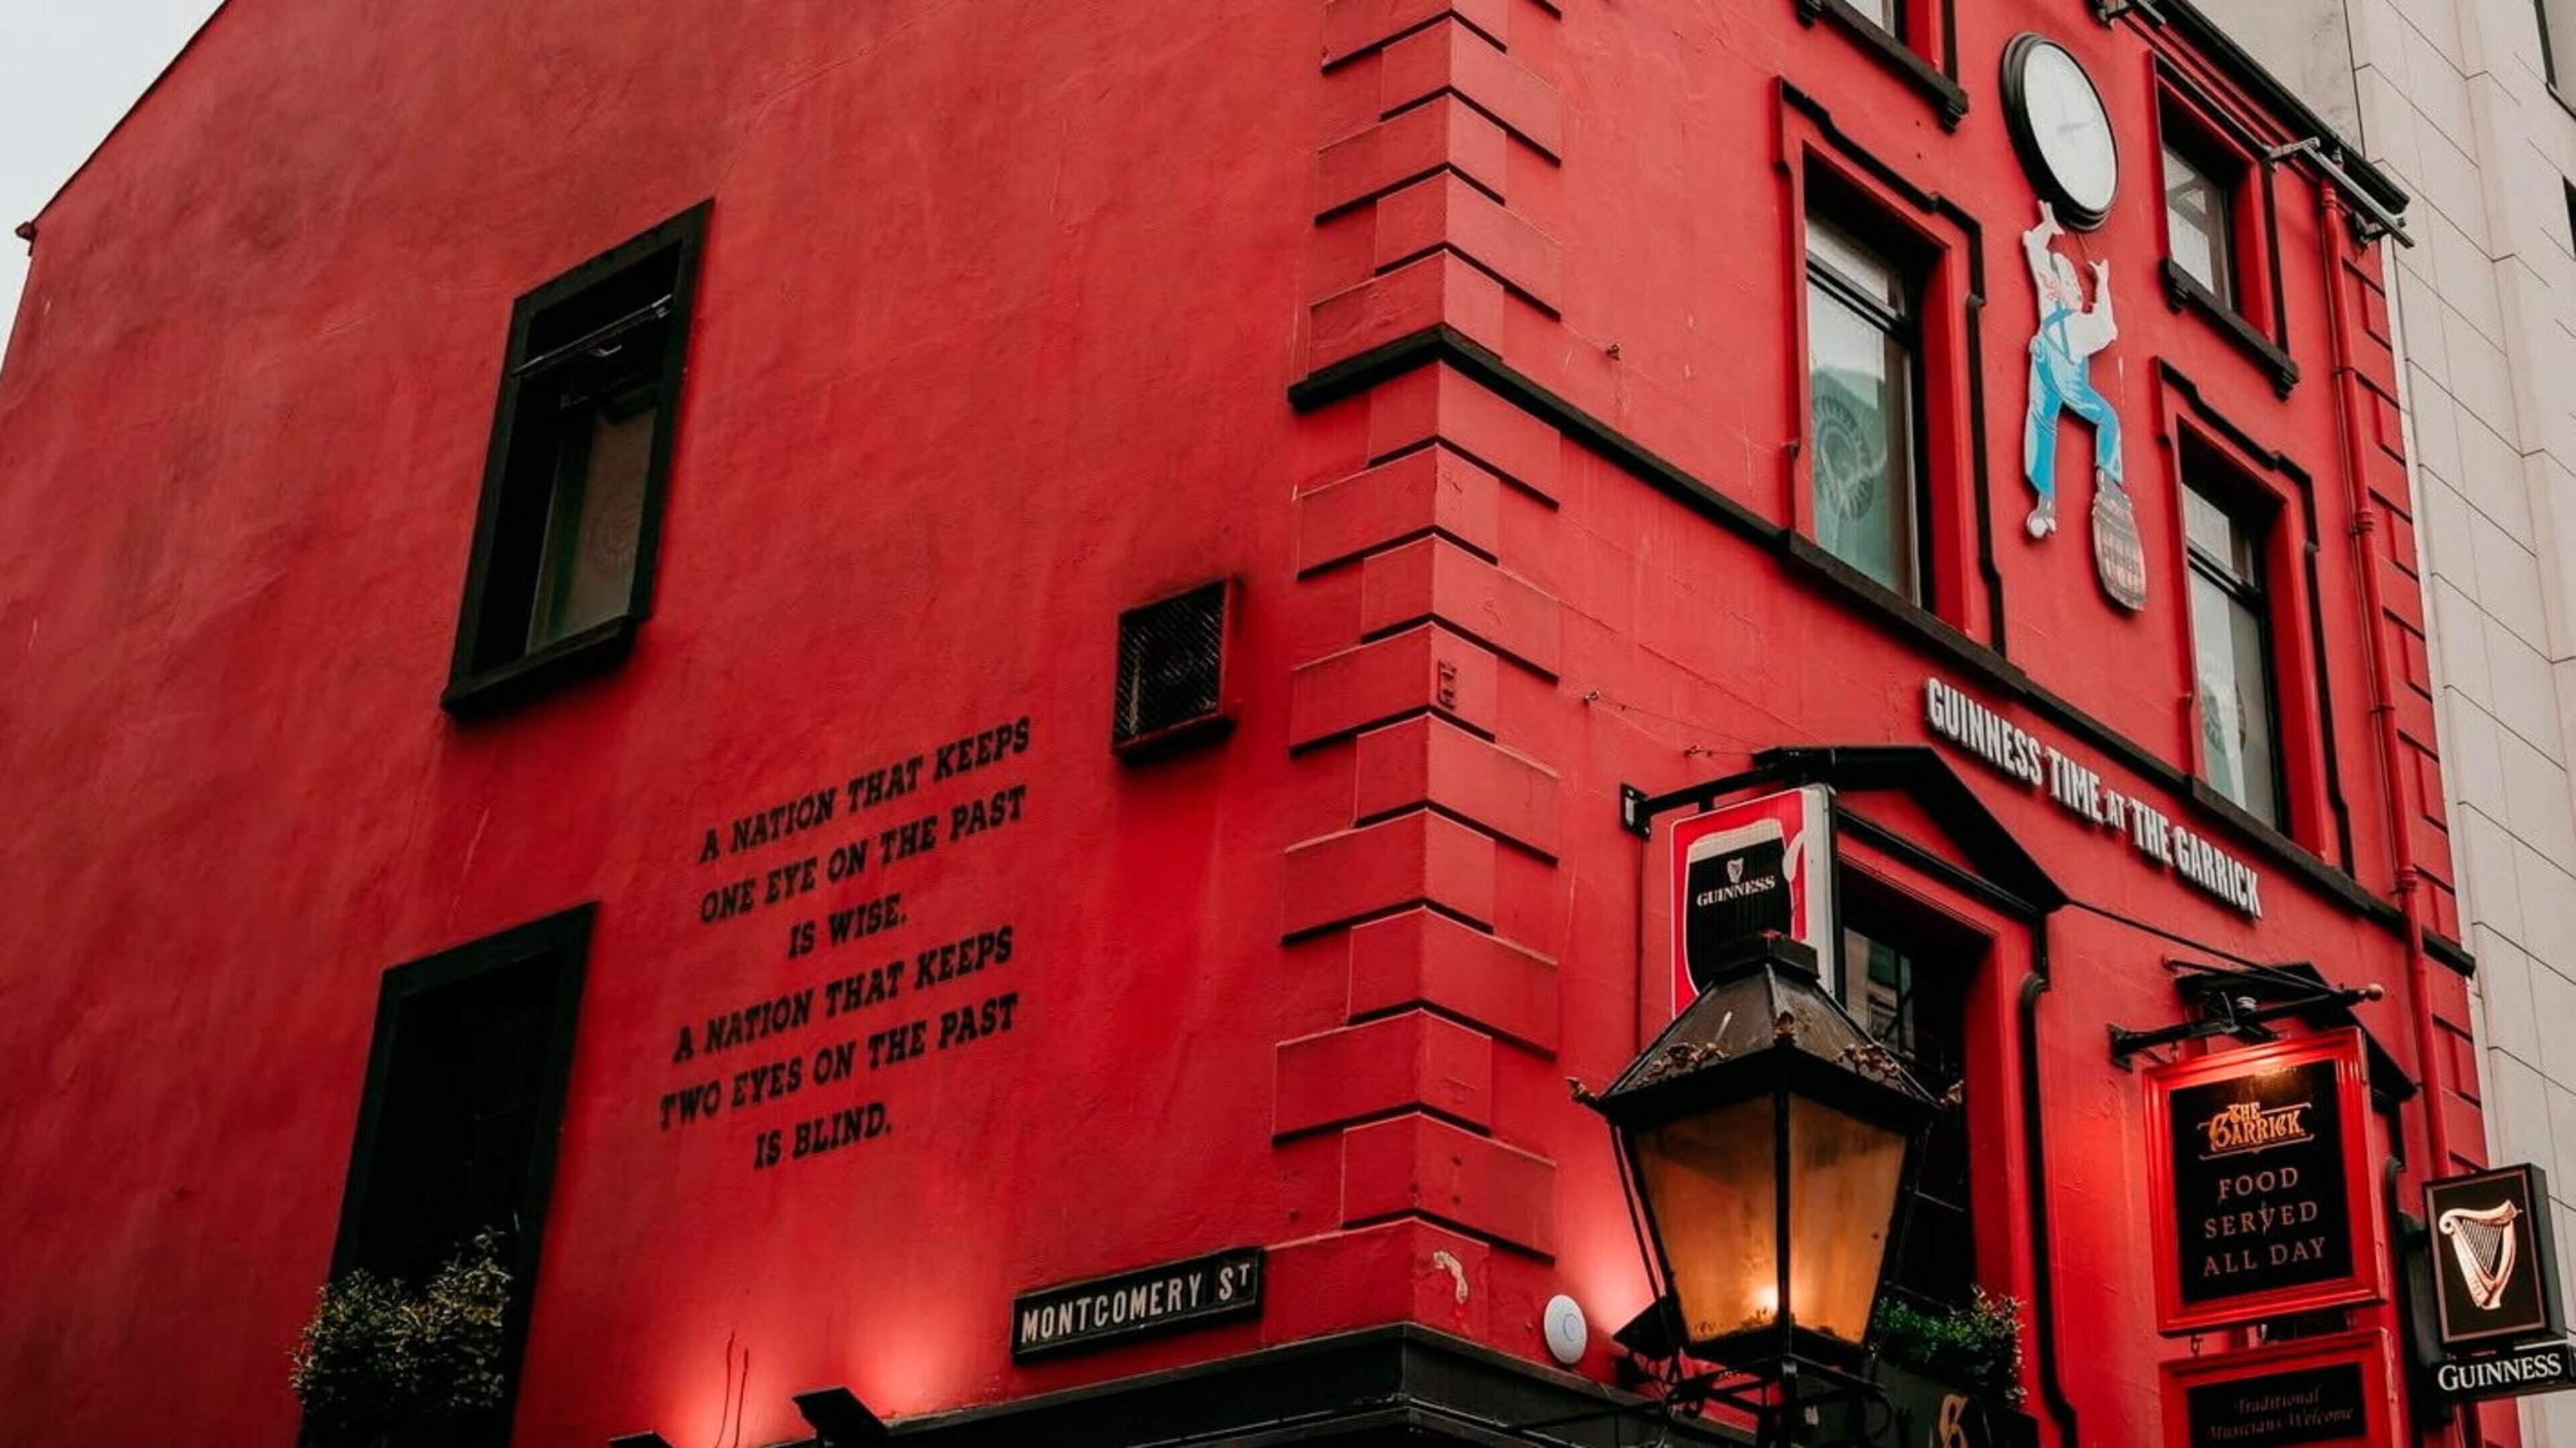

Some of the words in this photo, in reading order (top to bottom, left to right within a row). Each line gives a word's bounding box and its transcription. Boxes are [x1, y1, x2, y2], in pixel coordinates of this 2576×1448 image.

[700, 829, 719, 864] A
[731, 787, 836, 854] NATION
[847, 755, 923, 812] THAT
[933, 717, 1030, 782] KEEPS
[1926, 677, 2043, 786] GUINNESS
[2045, 746, 2104, 824] TIME
[2106, 789, 2126, 831] AT
[2129, 796, 2174, 868] THE
[2173, 825, 2261, 919] GARRICK
[700, 878, 756, 923] ONE
[765, 858, 817, 904] EYE
[827, 839, 868, 881] ON
[881, 815, 937, 864] THE
[949, 785, 1026, 840] PAST
[1697, 876, 1776, 907] GUINNESS
[788, 921, 815, 959] IS
[828, 894, 906, 946] WISE.
[674, 1025, 694, 1062] A
[704, 989, 812, 1054] NATION
[825, 961, 904, 1017] THAT
[914, 925, 1013, 989] KEEPS
[659, 1081, 720, 1129] TWO
[731, 1058, 802, 1107] EYES
[814, 1041, 855, 1086] ON
[869, 1020, 926, 1069] THE
[938, 992, 1018, 1048] PAST
[2208, 1110, 2306, 1151] GARRICK
[2228, 1102, 2261, 1123] THE
[753, 1131, 781, 1170] IS
[793, 1102, 892, 1159] BLIND.
[2218, 1167, 2298, 1200] FOOD
[2204, 1201, 2318, 1239] SERVED
[2204, 1250, 2257, 1276] ALL
[2271, 1237, 2326, 1265] DAY
[1219, 1264, 1250, 1301] ST
[2437, 1352, 2563, 1391] GUINNESS
[2235, 1383, 2322, 1416] Traditional
